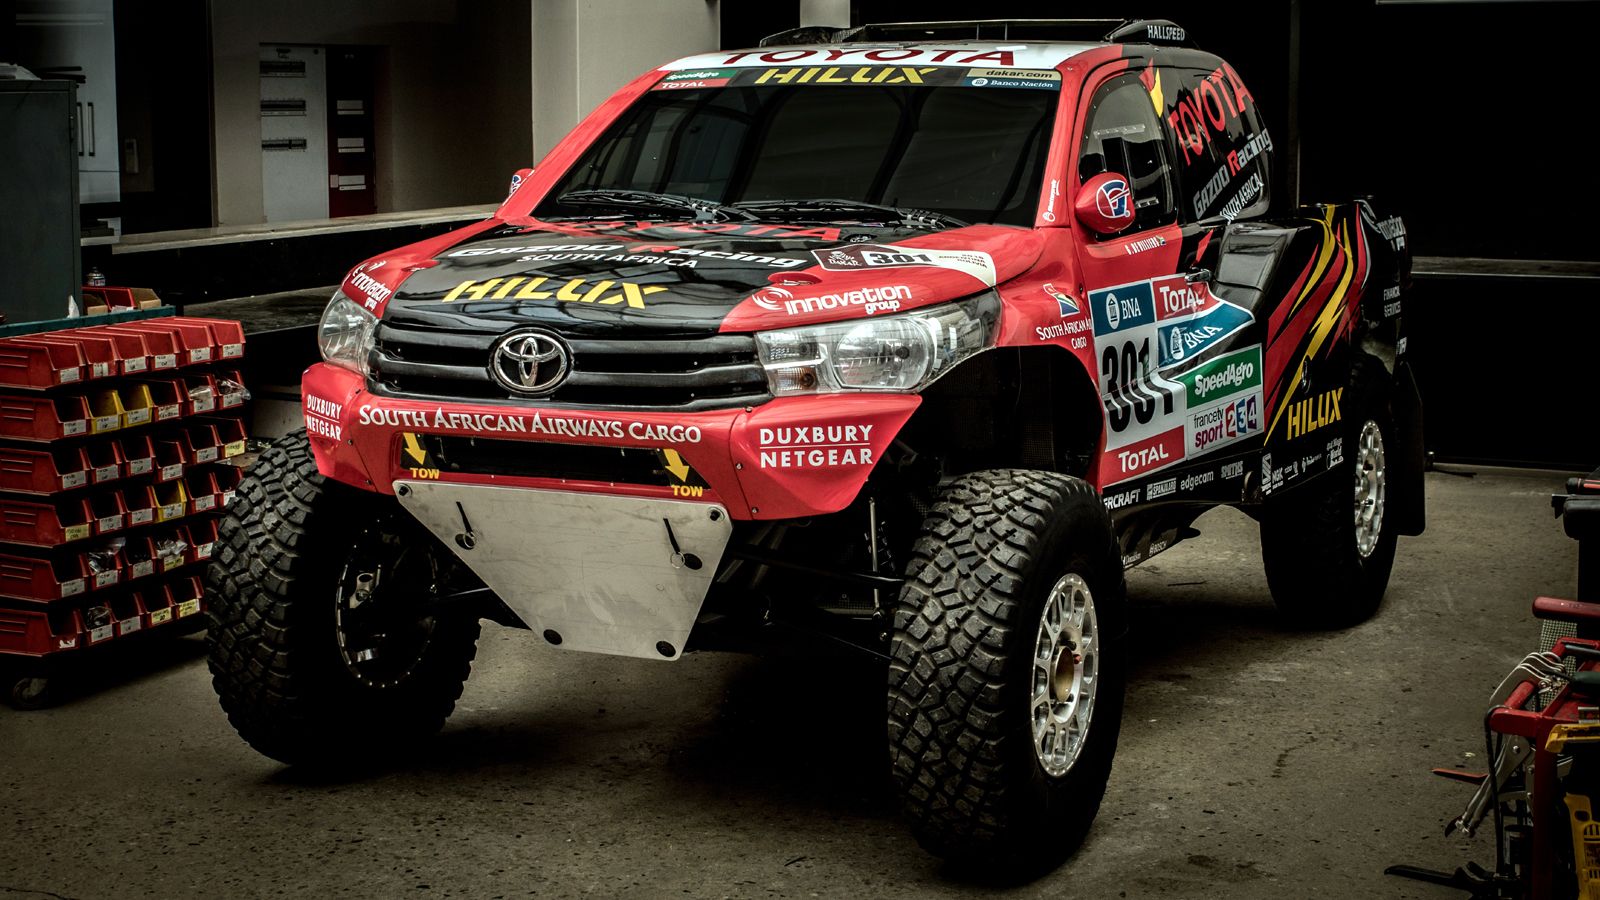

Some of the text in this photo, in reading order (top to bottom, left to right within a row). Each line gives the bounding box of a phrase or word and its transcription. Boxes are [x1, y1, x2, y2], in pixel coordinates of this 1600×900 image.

[1147, 25, 1185, 41] HALLSPEED
[722, 49, 1015, 67] TOYOTA
[661, 81, 707, 89] TOTAL
[753, 67, 939, 85] HILUX
[985, 69, 1053, 79] dakar.com
[1168, 61, 1255, 167] TOYOTA
[1192, 128, 1274, 220] GAZOO Racing
[1219, 172, 1265, 226] SOUTH AFRICA
[447, 244, 808, 268] GAZOO Racing
[516, 253, 699, 269] SOUTH AFRICA
[869, 253, 933, 265] 301
[442, 277, 669, 310] HILUX
[784, 285, 913, 316] innovation
[1159, 285, 1206, 313] TOTAL
[864, 299, 901, 315] group
[1120, 297, 1142, 320] BNA
[1035, 323, 1065, 341] SOUTH
[1062, 320, 1087, 336] AFRICAN
[1183, 325, 1223, 350] BNA
[1071, 336, 1088, 350] CARGO
[1102, 337, 1175, 433] 301
[1194, 361, 1255, 398] SpeedAgro
[306, 394, 343, 420] DUXBURY
[1287, 386, 1344, 441] HILUX
[306, 416, 342, 442] NETGEAR
[359, 404, 702, 443] SOUTH AFRICAN AIRWAYS CARGO
[760, 425, 873, 445] DUXBURY
[1194, 420, 1224, 450] sport
[760, 448, 873, 469] NETGEAR
[1118, 443, 1170, 473] TOTAL
[409, 467, 440, 480] TOW
[1180, 470, 1214, 492] edgecam
[670, 484, 704, 498] TOW
